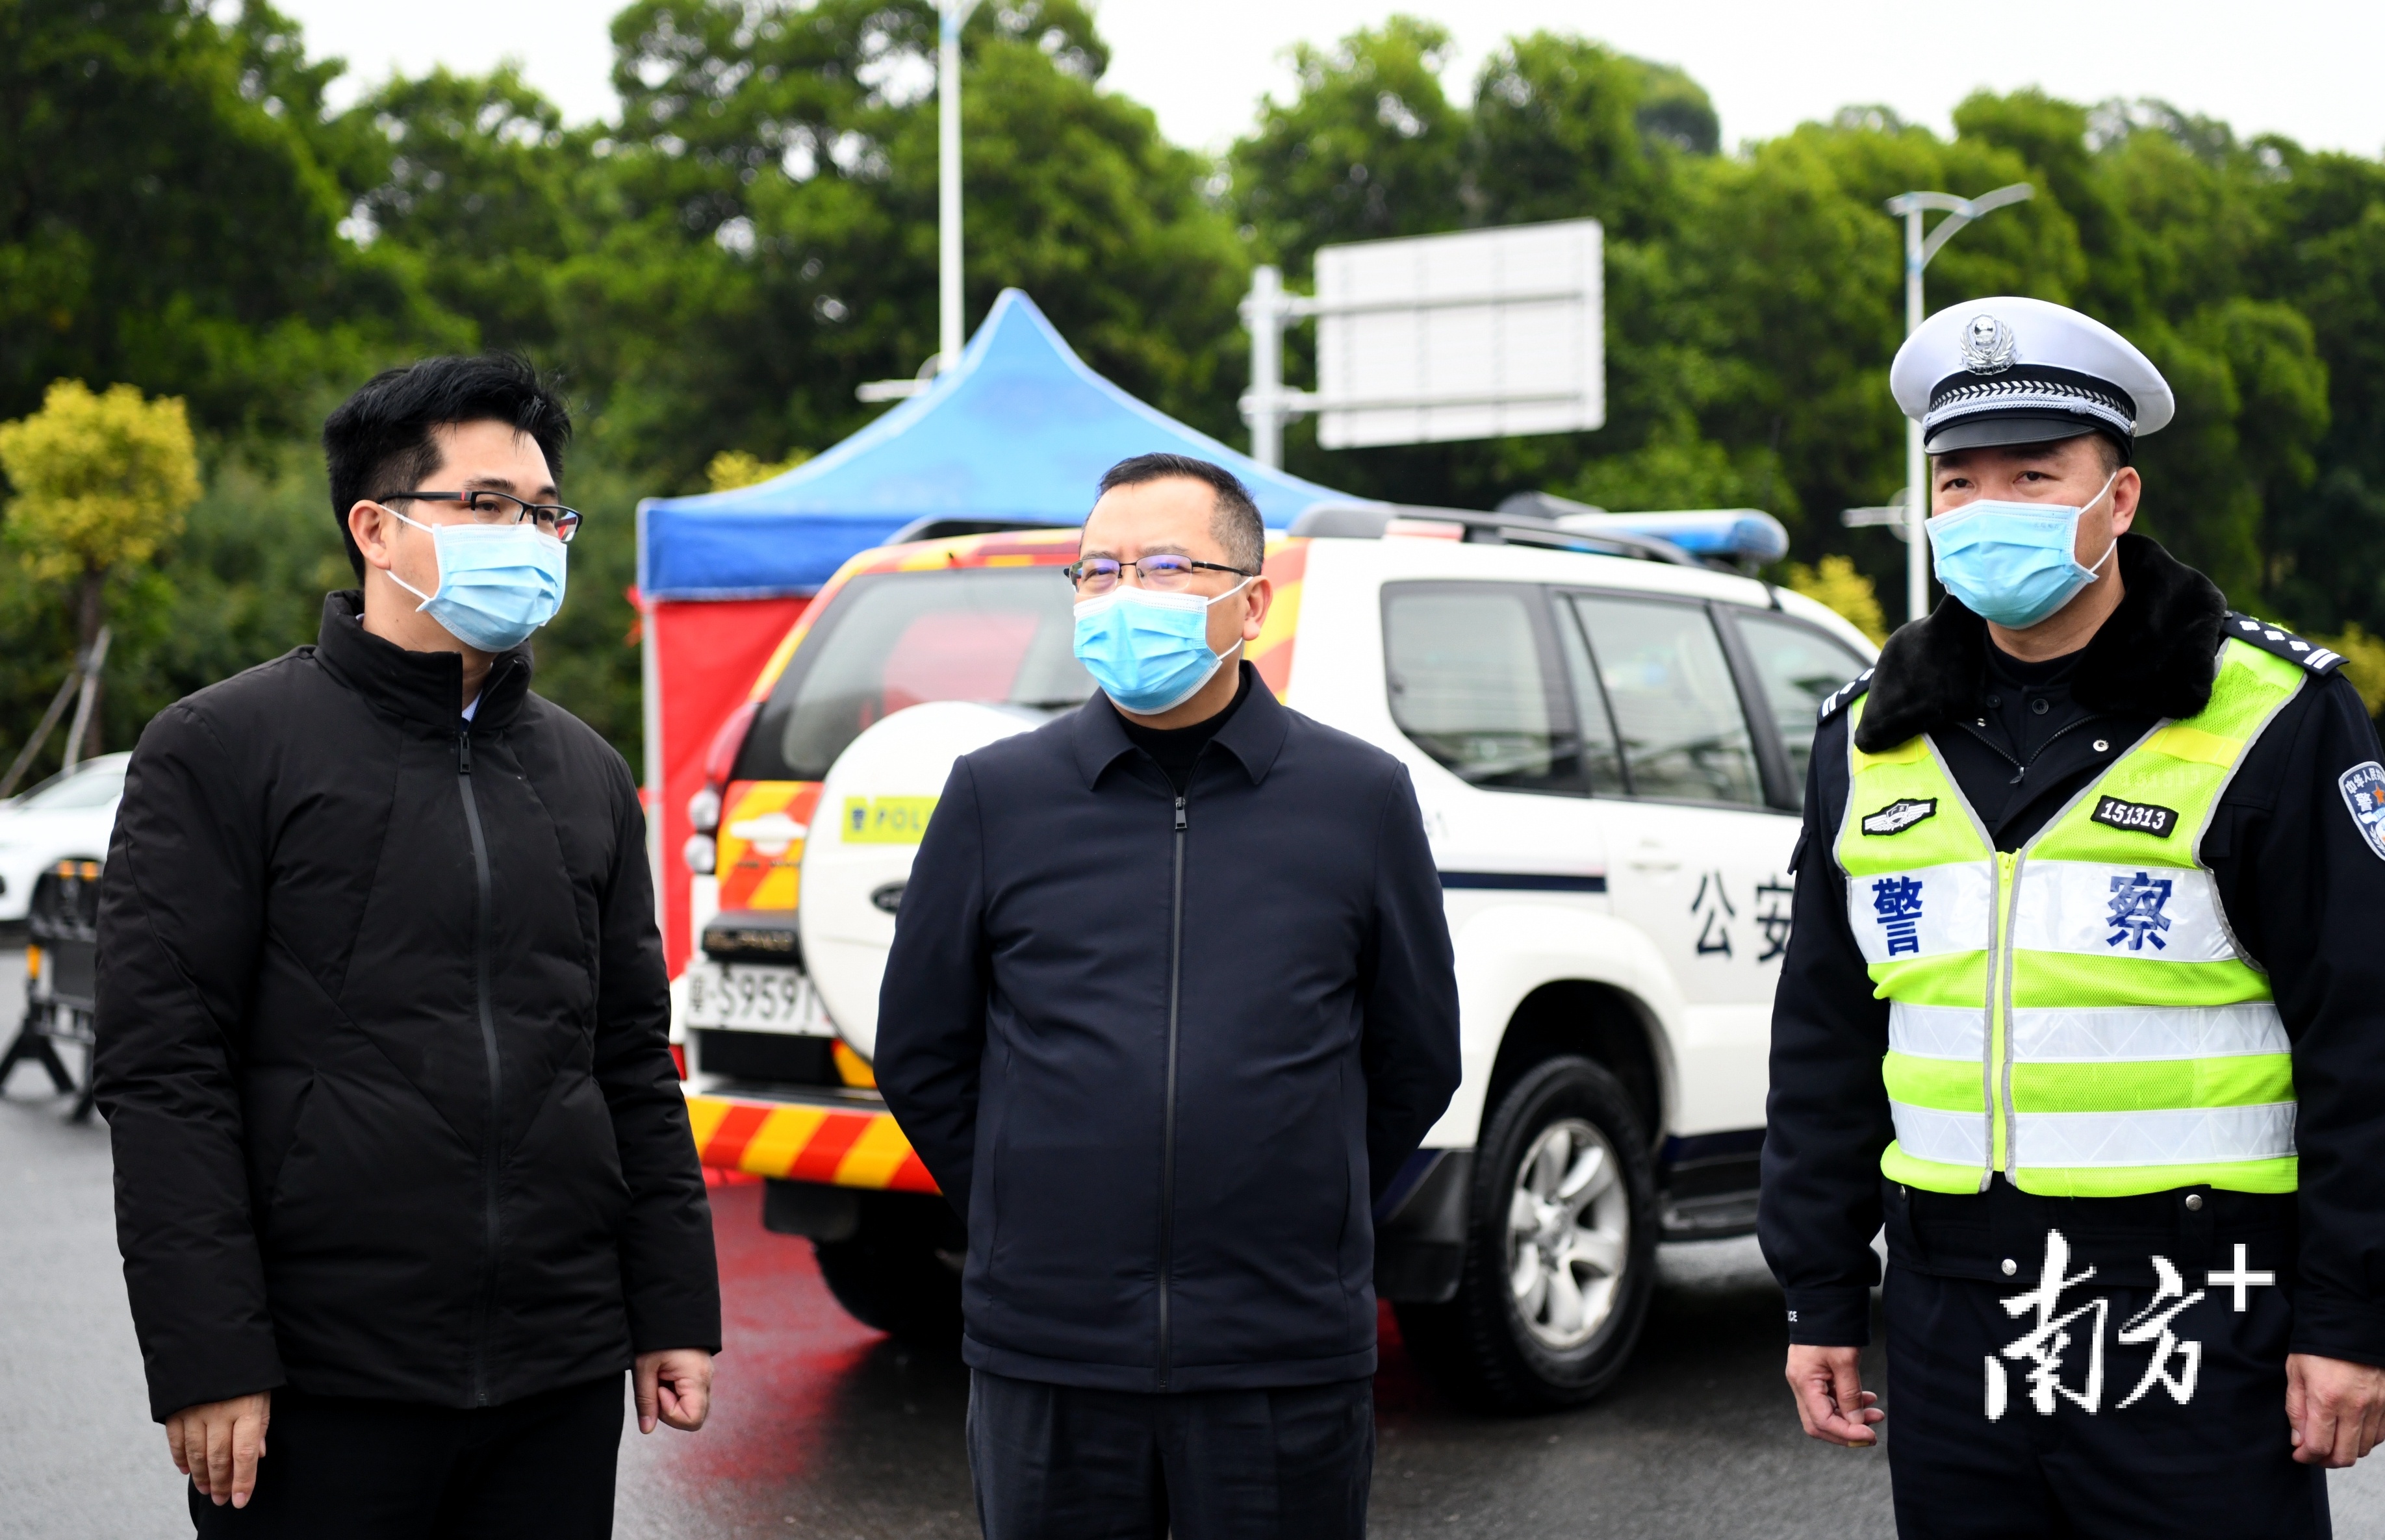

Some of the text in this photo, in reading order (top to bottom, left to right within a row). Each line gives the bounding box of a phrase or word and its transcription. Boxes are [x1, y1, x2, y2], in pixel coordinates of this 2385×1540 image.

[2100, 801, 2167, 829] 151313
[2354, 792, 2373, 812] 警
[1691, 870, 1793, 962] 公安
[1872, 872, 2173, 957] 警 察
